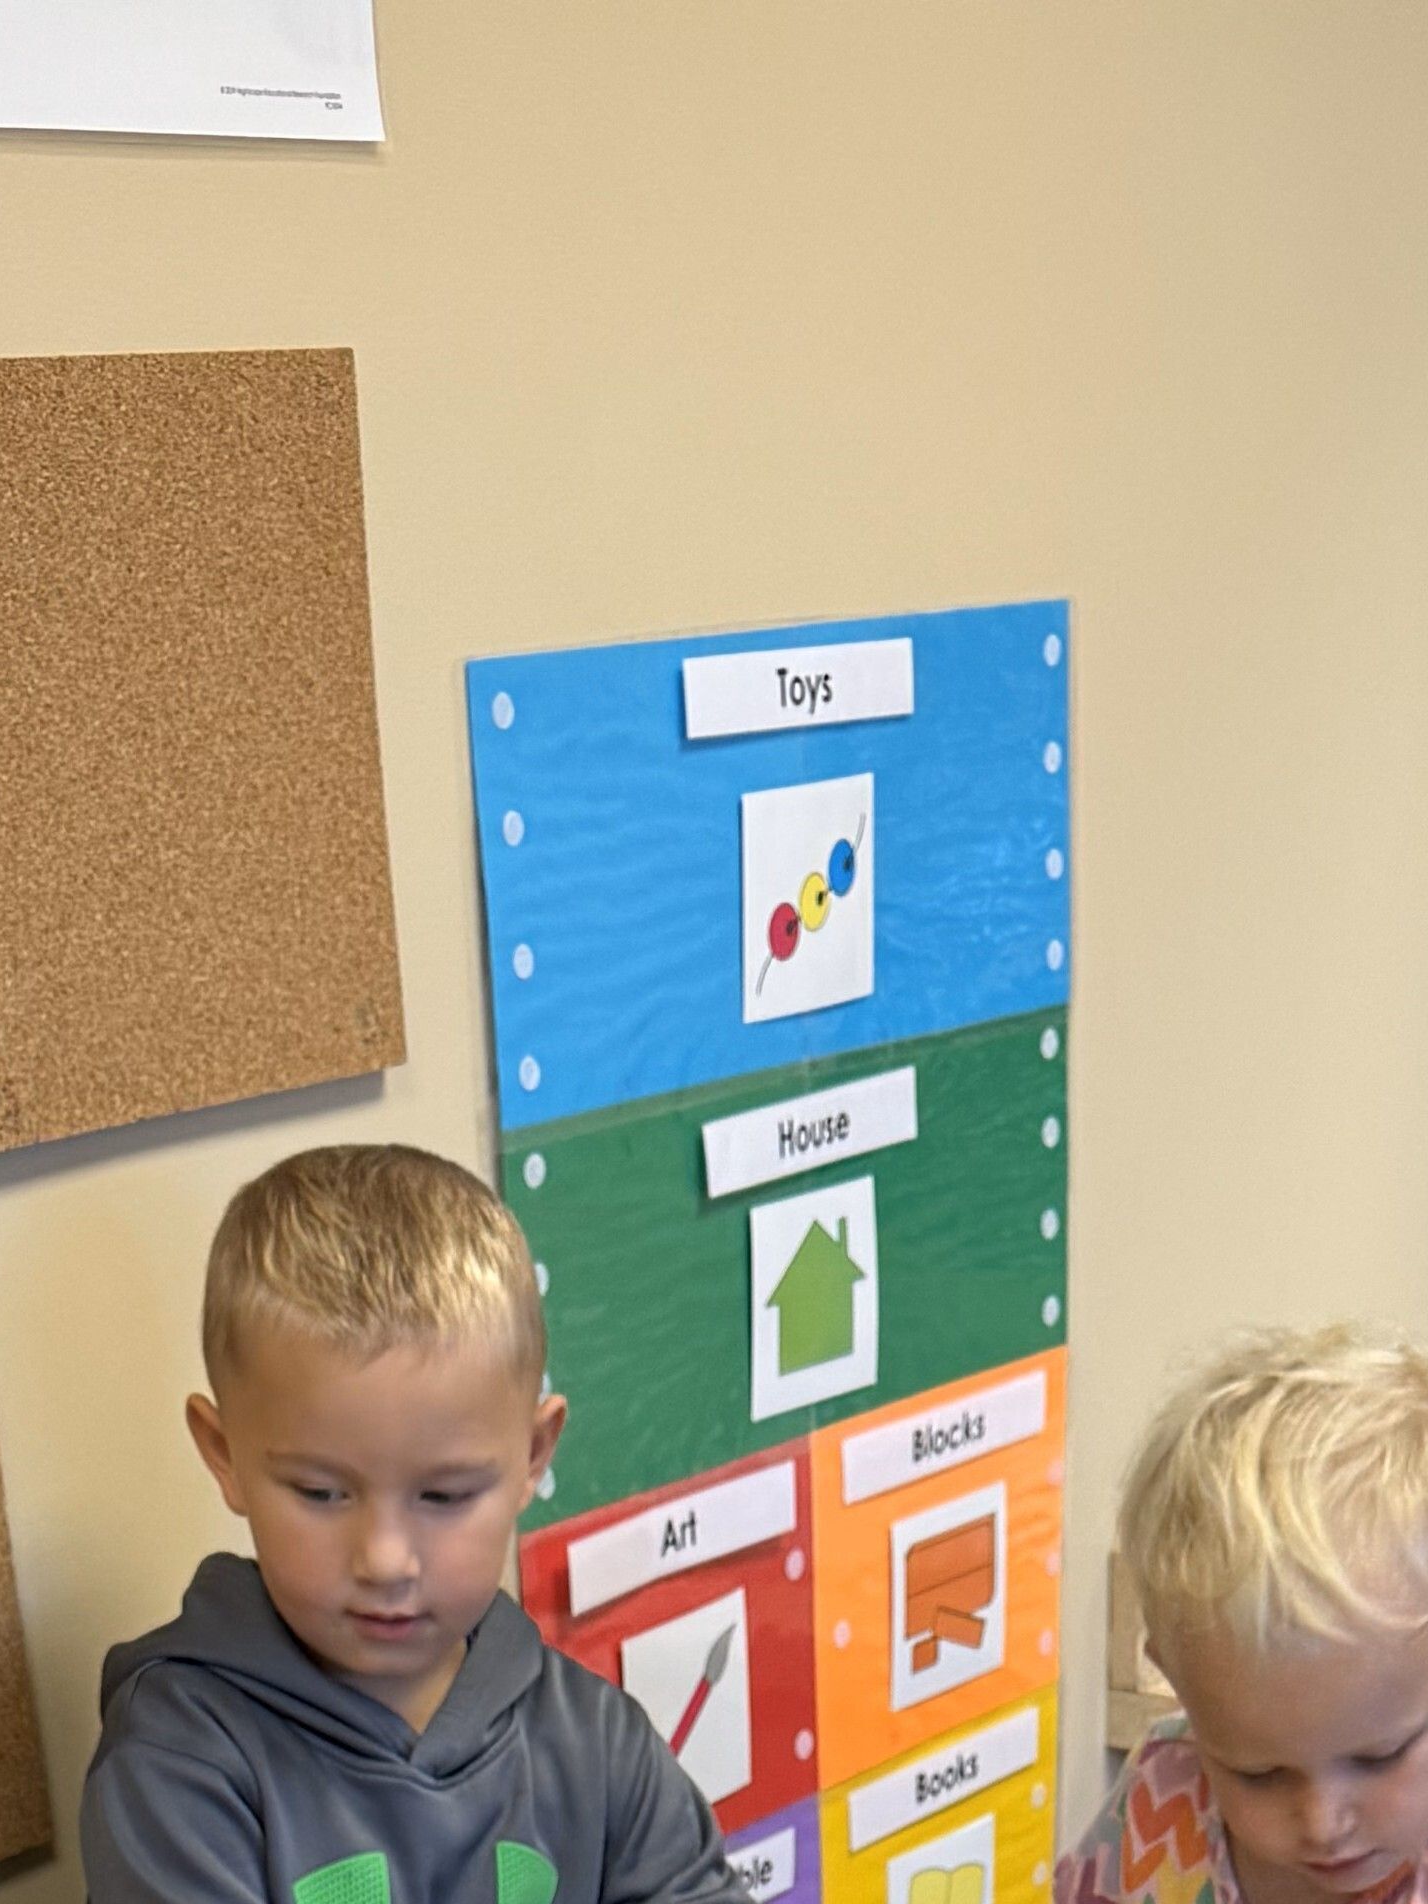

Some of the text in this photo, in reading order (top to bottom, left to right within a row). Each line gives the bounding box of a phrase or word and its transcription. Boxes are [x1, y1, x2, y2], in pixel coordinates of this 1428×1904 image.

[776, 667, 832, 715] Toys
[777, 1113, 849, 1158] House
[913, 1411, 985, 1461] Blocks
[661, 1510, 697, 1557] Art
[915, 1754, 978, 1803] Books
